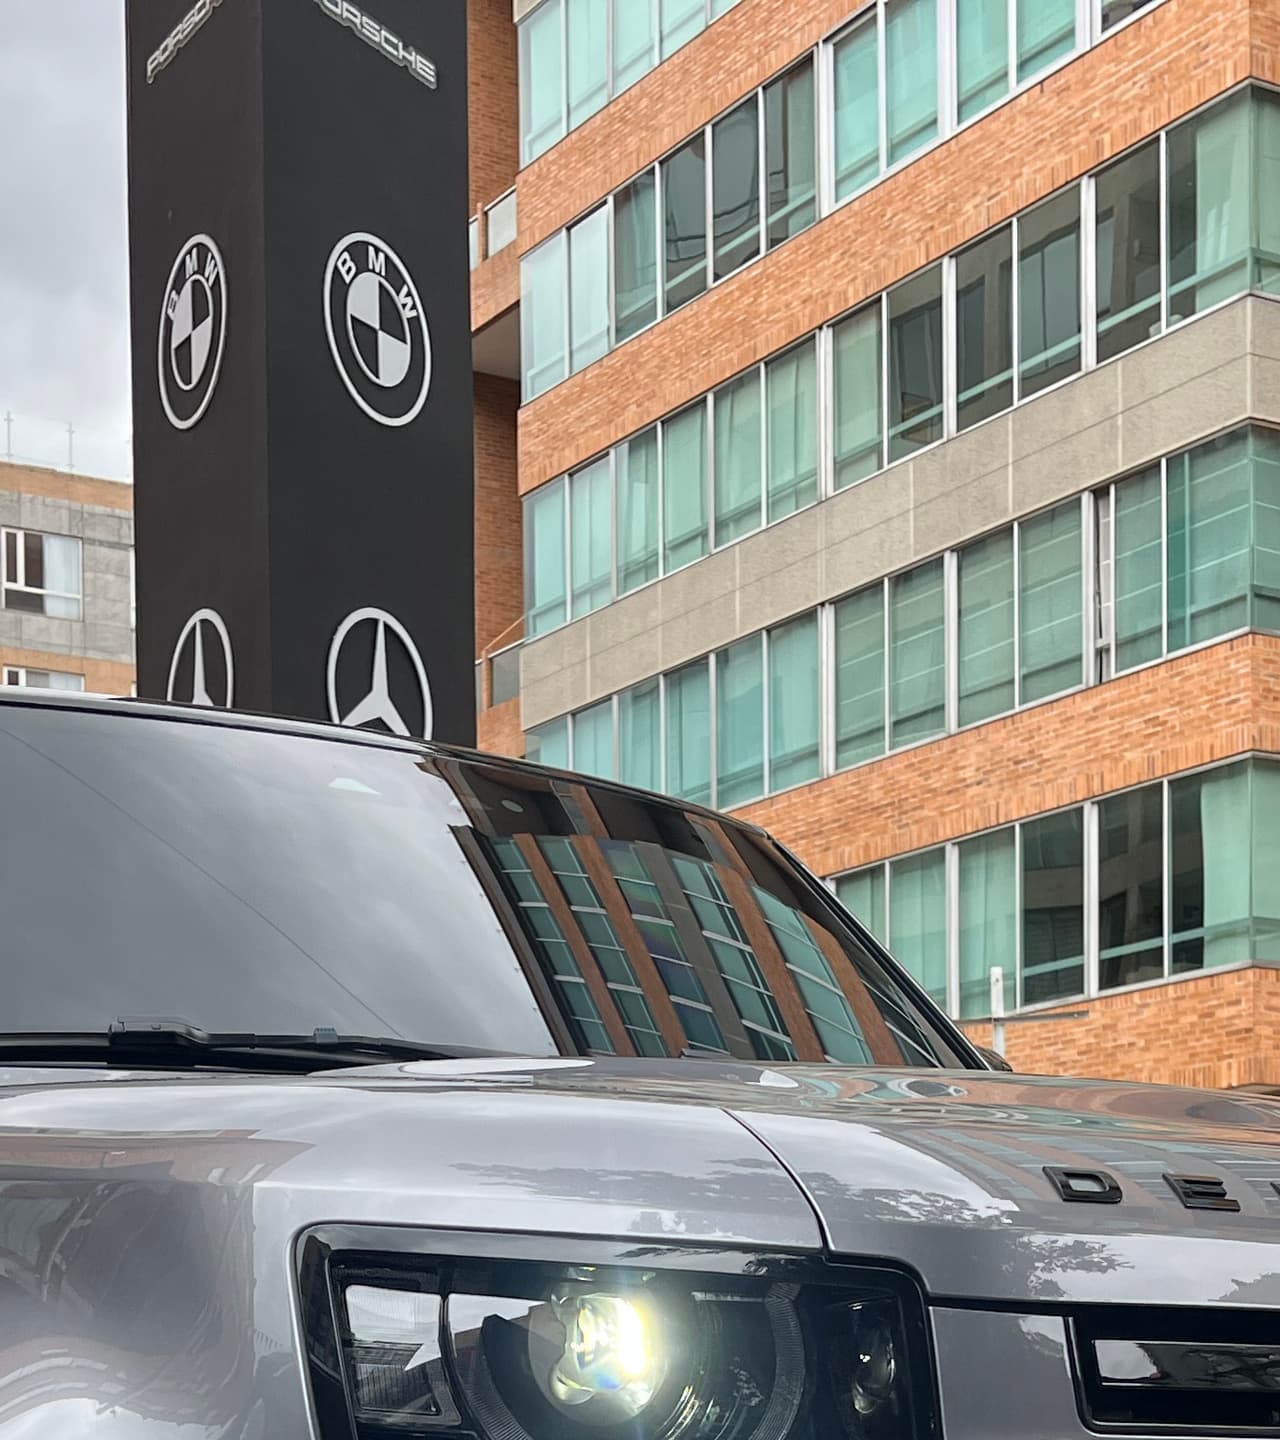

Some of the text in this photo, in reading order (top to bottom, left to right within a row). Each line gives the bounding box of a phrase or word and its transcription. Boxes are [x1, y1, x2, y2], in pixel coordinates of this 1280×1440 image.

[317, 0, 437, 89] ORSCHE
[167, 248, 219, 321] BMW
[336, 245, 418, 319] BMW
